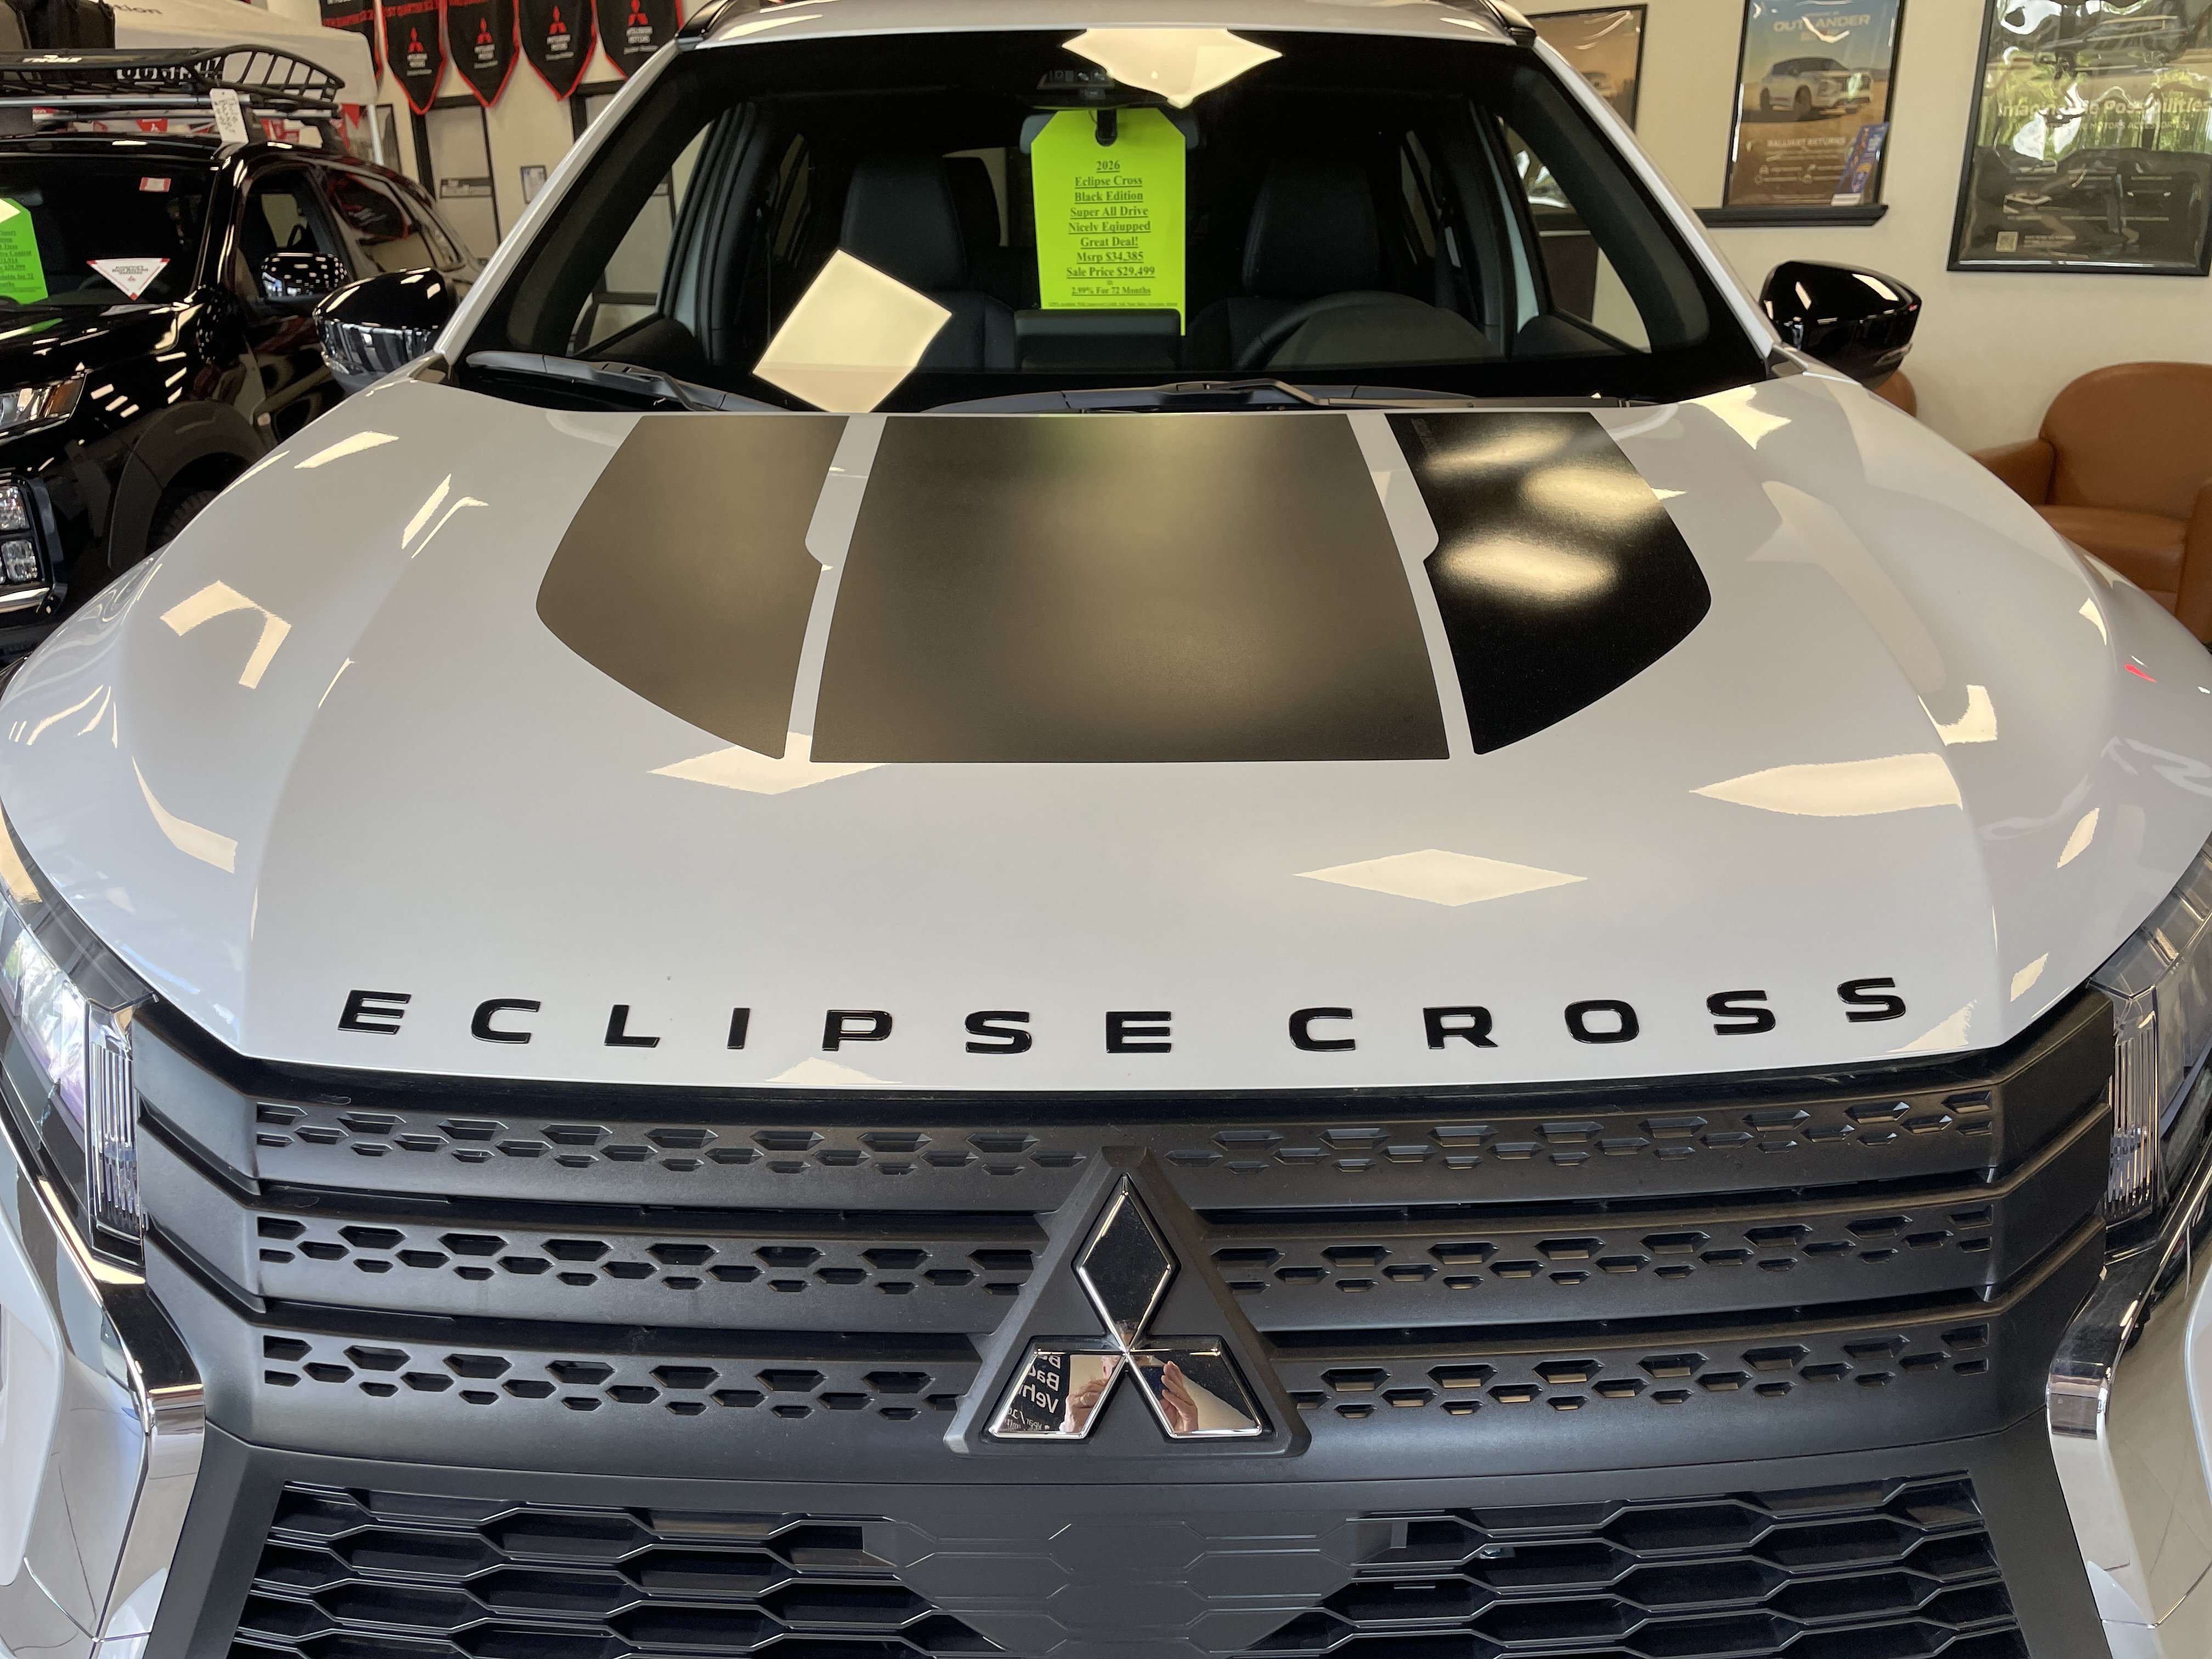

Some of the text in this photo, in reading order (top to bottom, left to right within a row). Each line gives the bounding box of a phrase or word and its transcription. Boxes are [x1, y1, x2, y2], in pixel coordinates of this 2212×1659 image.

[1773, 14, 1871, 32] OUTANDER
[1097, 160, 1120, 171] 2026
[1075, 176, 1142, 188] Eclipse Cross
[1075, 190, 1143, 202] Black Edition
[1070, 206, 1148, 217] Super All Drive
[1102, 221, 1150, 232] Eqiupped
[1081, 236, 1138, 247] Great Deal!
[1077, 251, 1143, 263] Msrp $34,385
[1066, 266, 1155, 276] Sale Price $29,499
[339, 977, 1906, 1054] ECLIPSE CROSS
